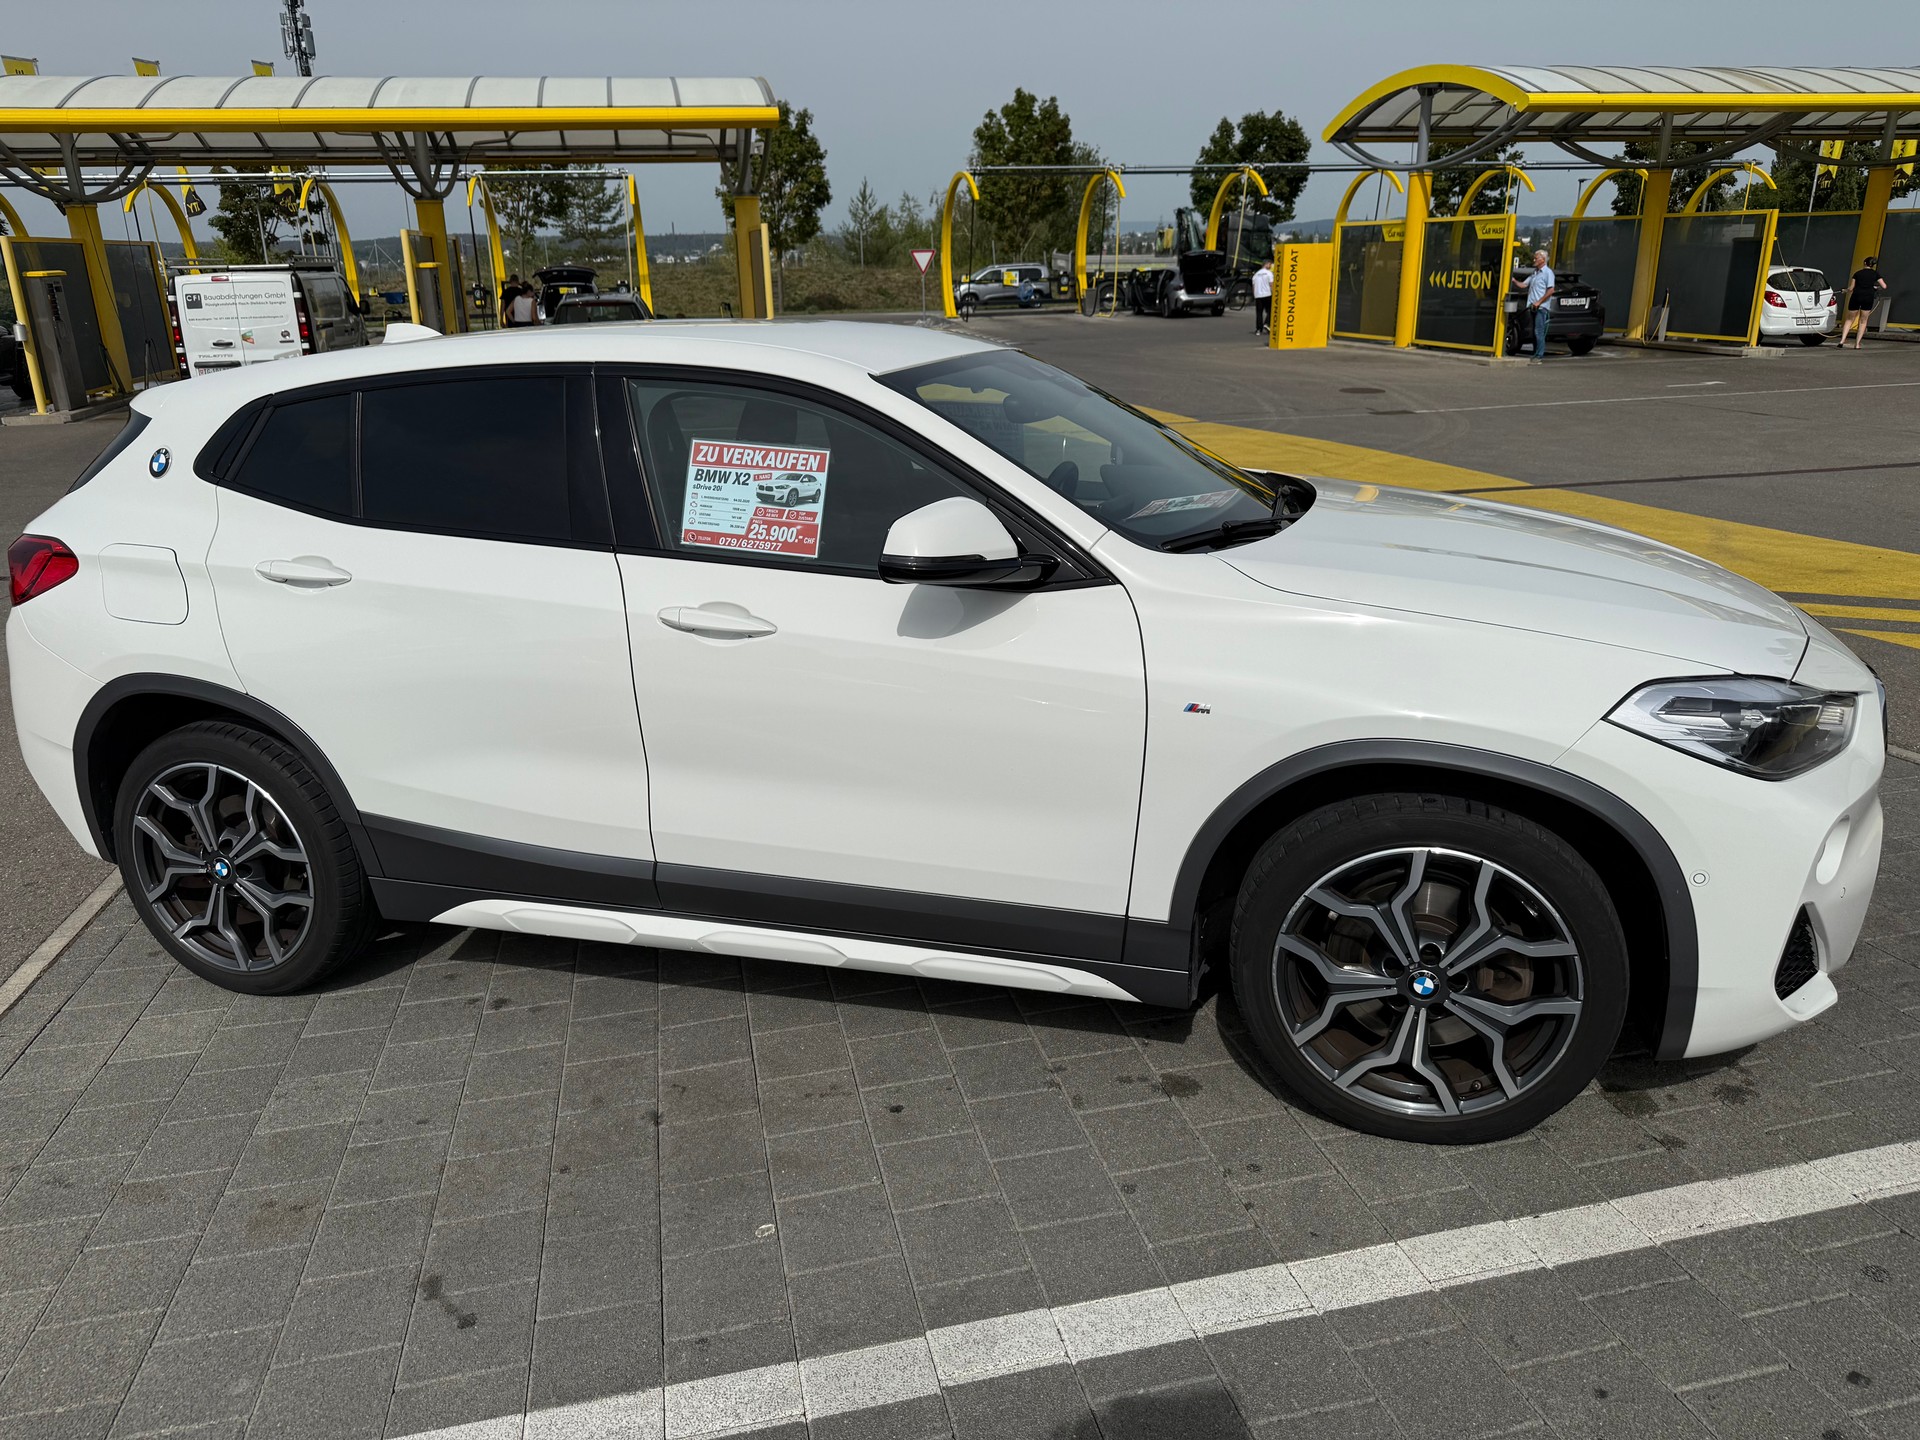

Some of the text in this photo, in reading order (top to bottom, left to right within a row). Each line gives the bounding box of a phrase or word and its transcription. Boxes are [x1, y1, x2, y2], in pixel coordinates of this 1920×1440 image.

[1447, 270, 1492, 289] JETON
[186, 294, 201, 302] CFI
[203, 293, 263, 301] Bauabdichtungen
[1272, 251, 1282, 343] JETONAUTOMAT
[1286, 249, 1299, 342] JETONAUTOMAT
[696, 445, 820, 471] ZU VERKAUFEN
[694, 468, 751, 486] BMW X2
[692, 483, 712, 491] sDrive
[748, 523, 803, 543] 25.900.-
[719, 536, 783, 551] 079/6275977
